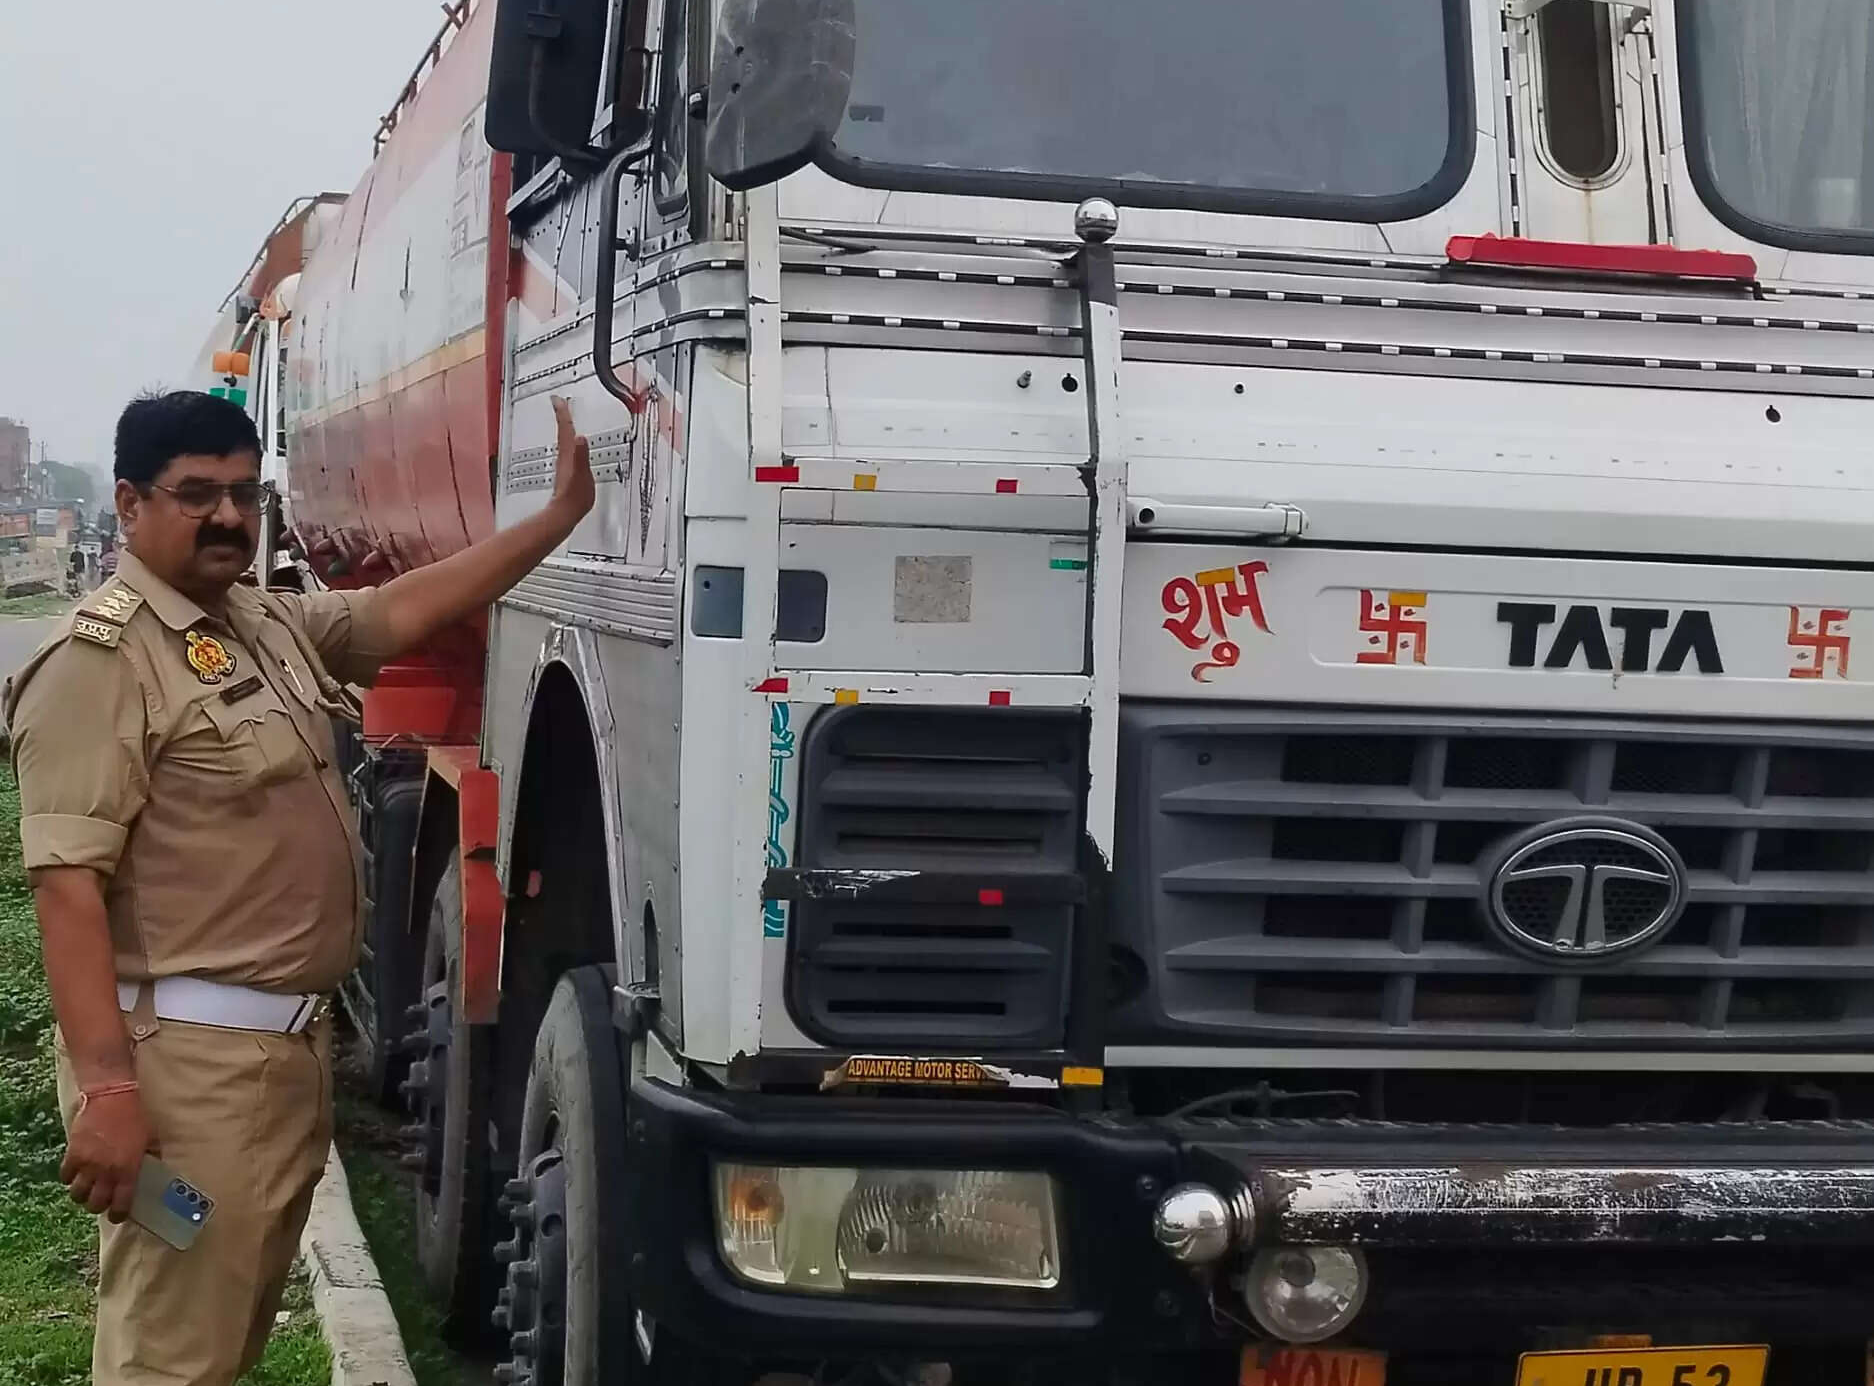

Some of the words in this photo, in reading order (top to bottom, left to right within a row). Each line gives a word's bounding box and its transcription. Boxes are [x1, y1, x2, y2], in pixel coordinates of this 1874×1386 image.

[1497, 601, 1724, 674] TATA
[848, 1060, 912, 1077] ADVANTAGE
[915, 1062, 952, 1078] MOTOR
[955, 1063, 983, 1080] SERV
